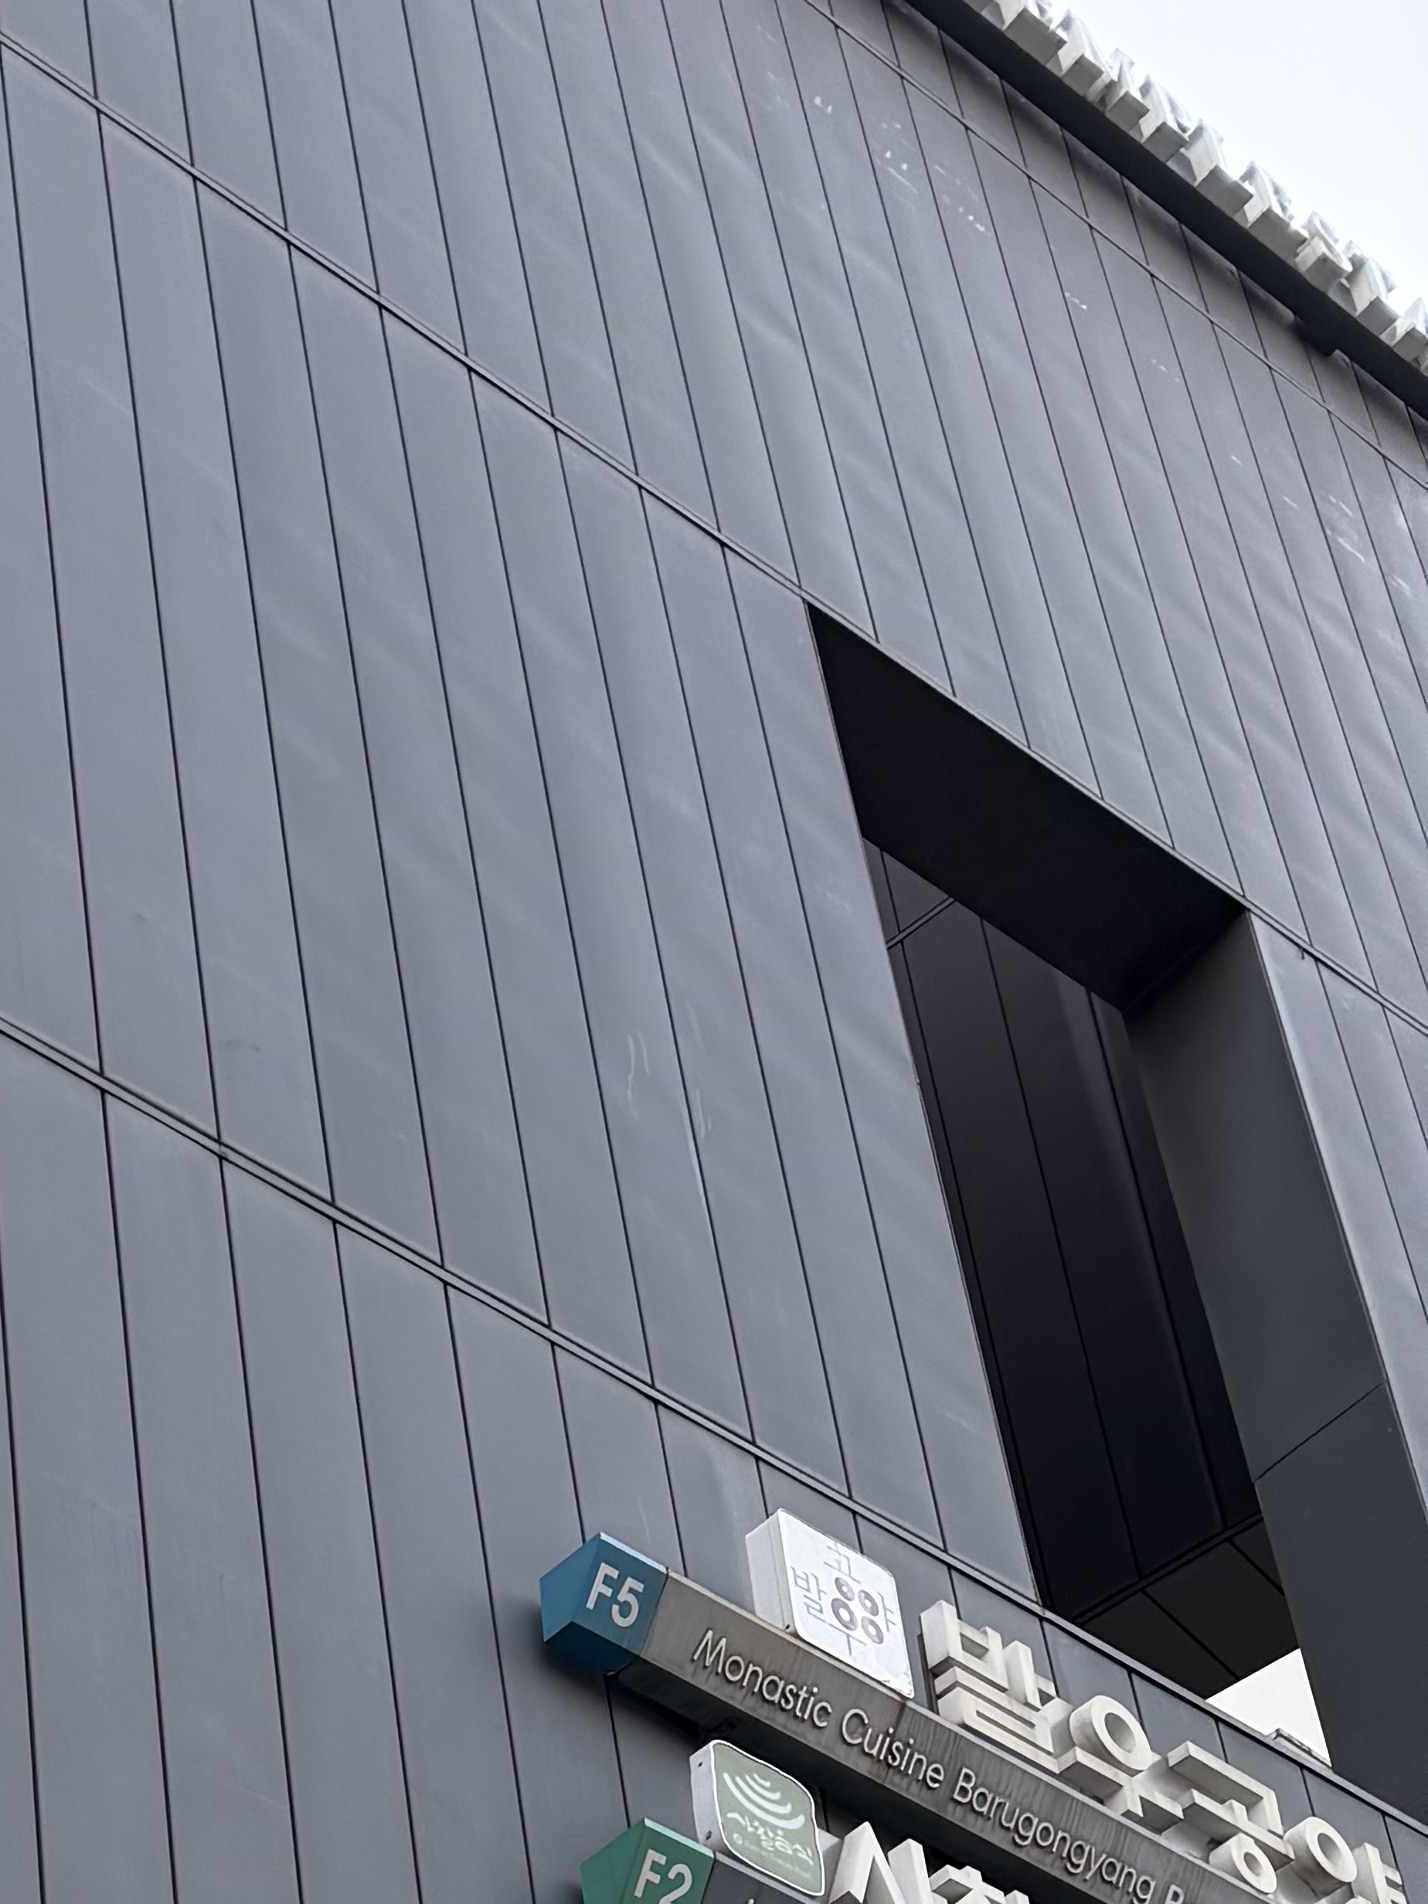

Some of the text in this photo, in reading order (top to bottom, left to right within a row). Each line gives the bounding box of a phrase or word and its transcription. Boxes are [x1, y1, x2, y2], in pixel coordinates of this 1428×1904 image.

[586, 1561, 645, 1628] F5
[691, 1629, 832, 1728] Monastic
[842, 1708, 945, 1789] Cuisine
